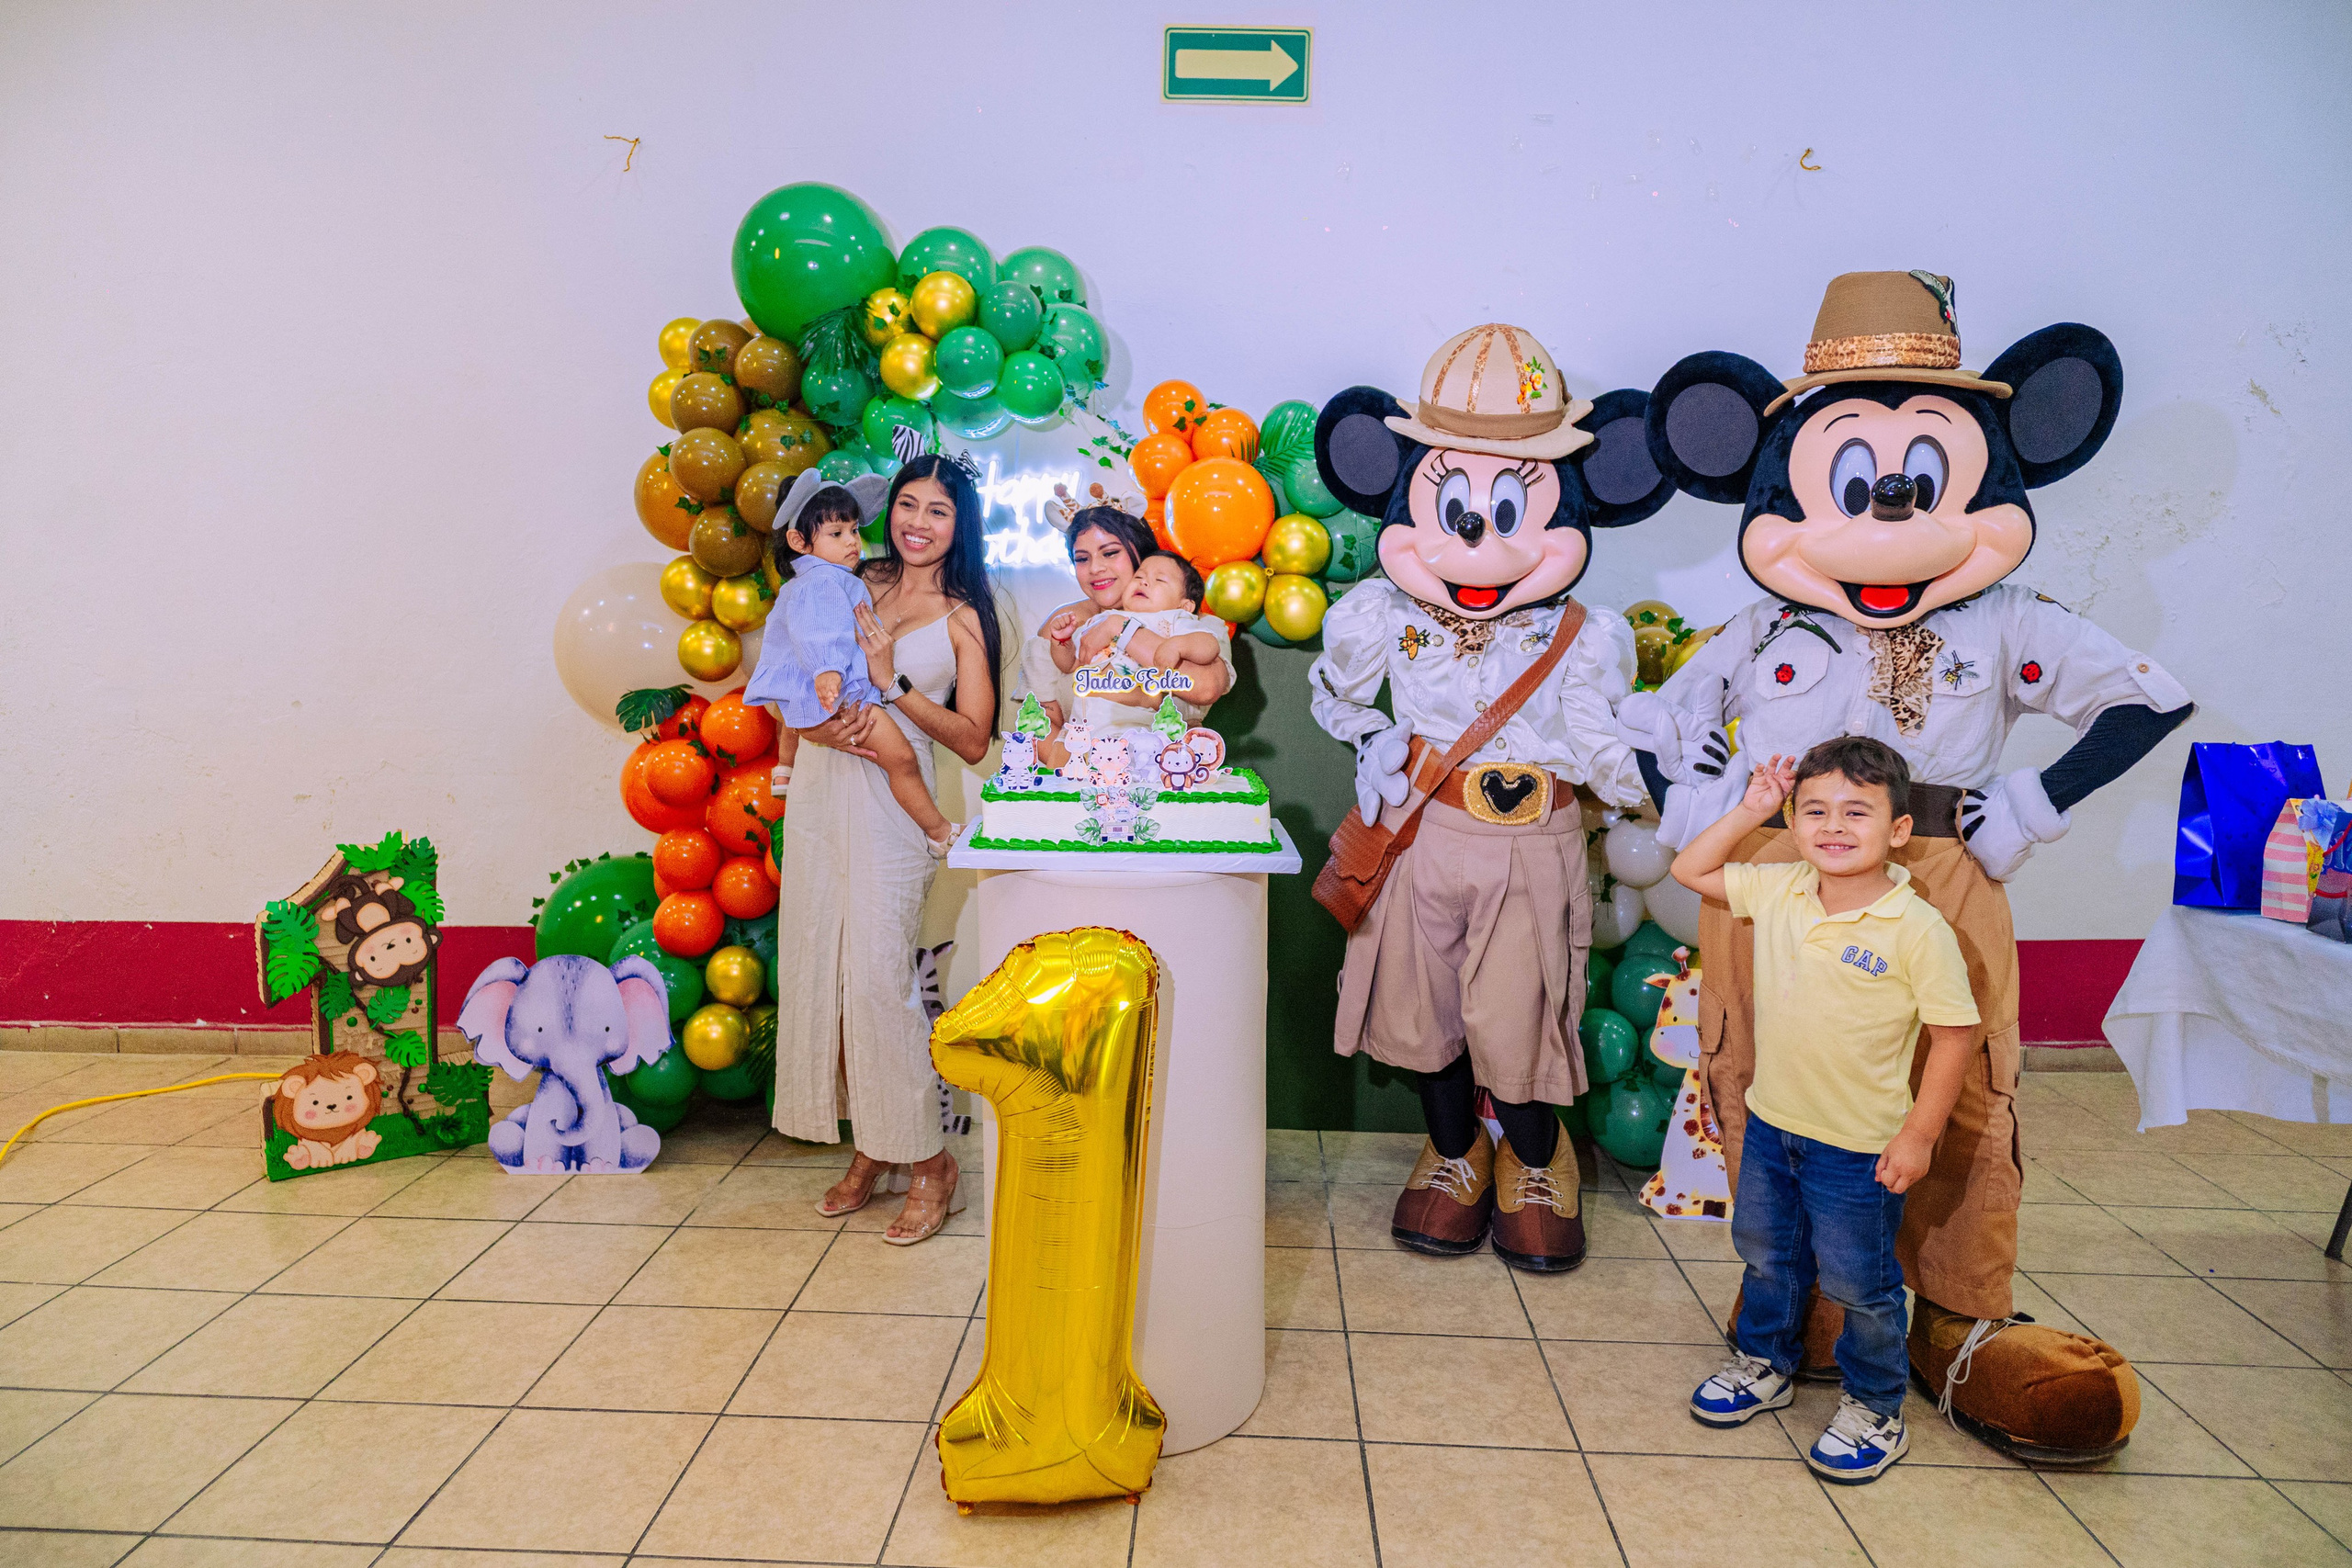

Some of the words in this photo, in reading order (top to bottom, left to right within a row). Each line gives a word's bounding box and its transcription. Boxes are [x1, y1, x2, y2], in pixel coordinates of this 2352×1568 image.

[1075, 667, 1135, 694] Tadeo
[1136, 667, 1193, 694] Edén
[1840, 945, 1888, 976] GAP
[929, 926, 1165, 1516] 1
